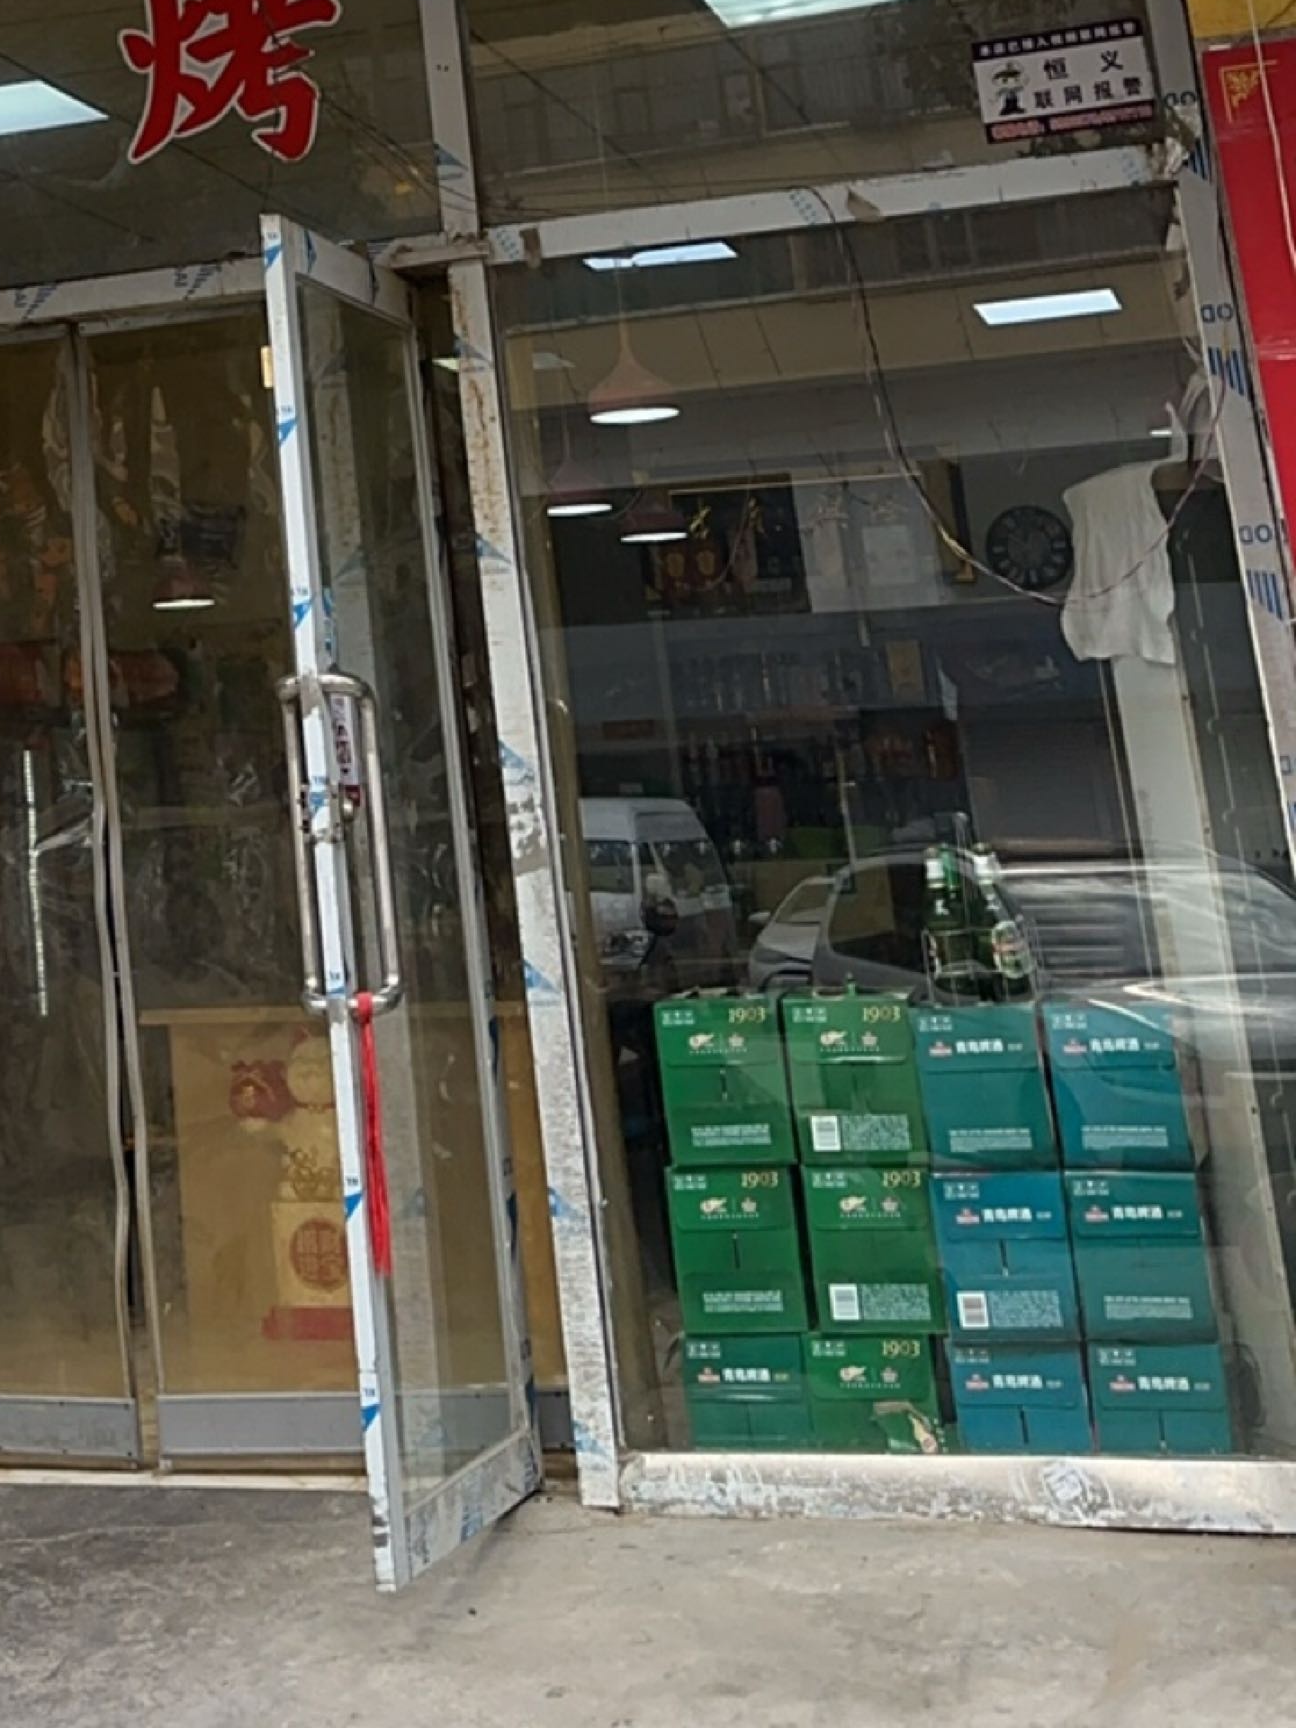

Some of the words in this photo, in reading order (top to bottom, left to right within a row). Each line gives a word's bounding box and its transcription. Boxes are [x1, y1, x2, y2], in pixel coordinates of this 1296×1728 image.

[1043, 49, 1124, 80] 恒义
[1034, 76, 1142, 110] 联网报警
[728, 1006, 766, 1024] 1903
[862, 1005, 901, 1024] 1903
[741, 1171, 779, 1188] 1903
[883, 1170, 921, 1188] 1903
[883, 1340, 921, 1358] 1903
